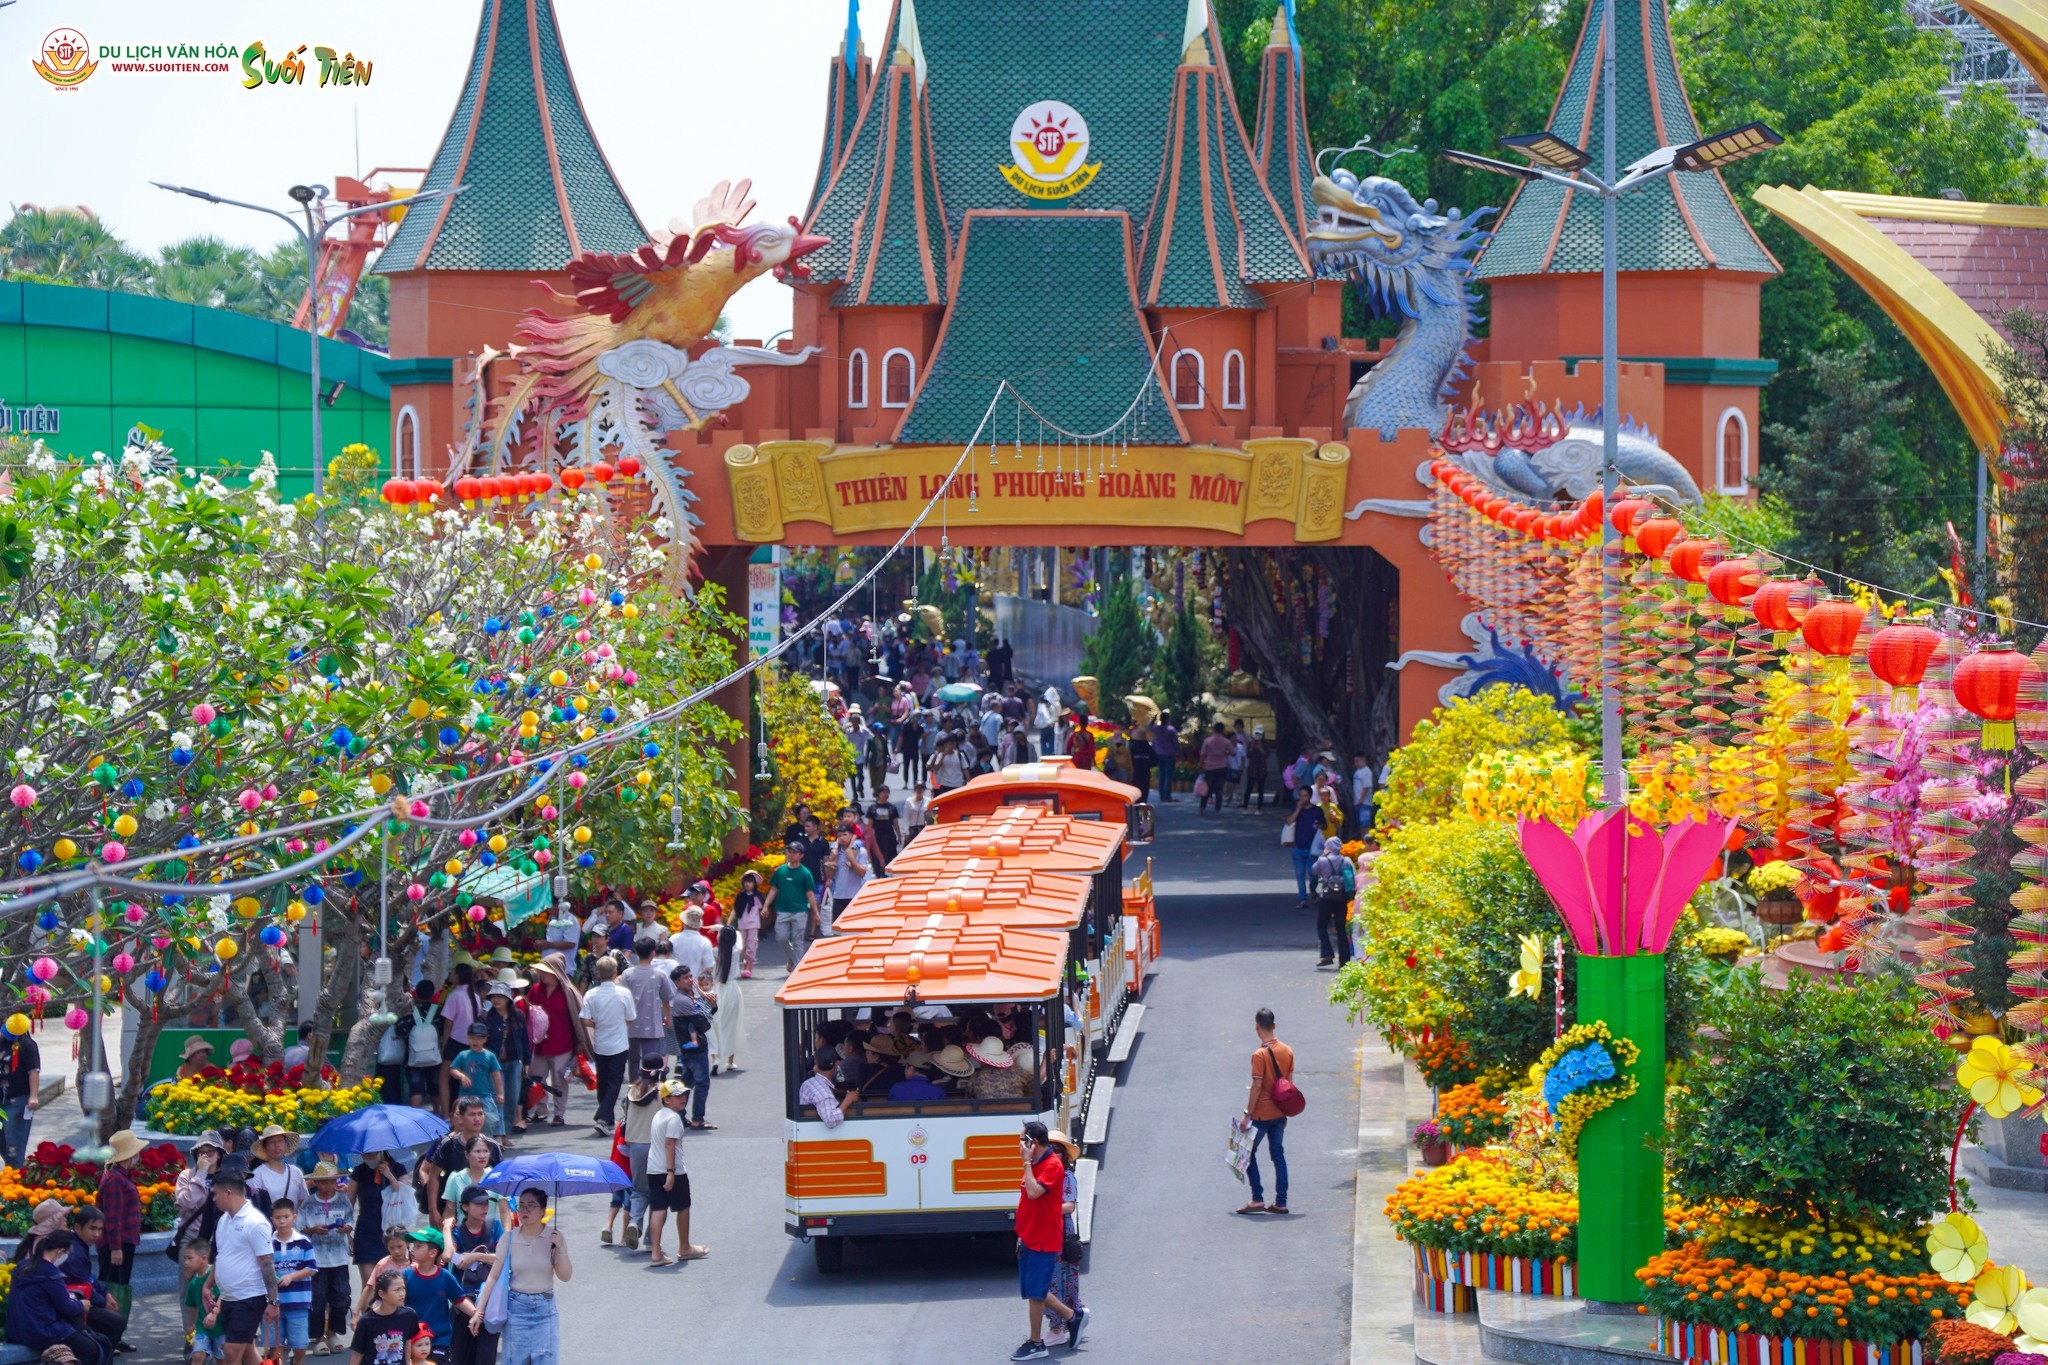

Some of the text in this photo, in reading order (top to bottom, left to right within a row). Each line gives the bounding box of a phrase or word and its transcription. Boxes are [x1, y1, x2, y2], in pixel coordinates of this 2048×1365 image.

[1037, 131, 1060, 152] STF
[1010, 170, 1091, 196] DU LỊCH SUỐI TIÊN
[17, 403, 60, 433] TIÊN
[835, 472, 908, 507] THIÊN
[919, 473, 979, 500] LONG
[1098, 469, 1176, 498] HOÀNG
[1188, 472, 1245, 506] MÔN
[911, 1154, 927, 1164] 09
